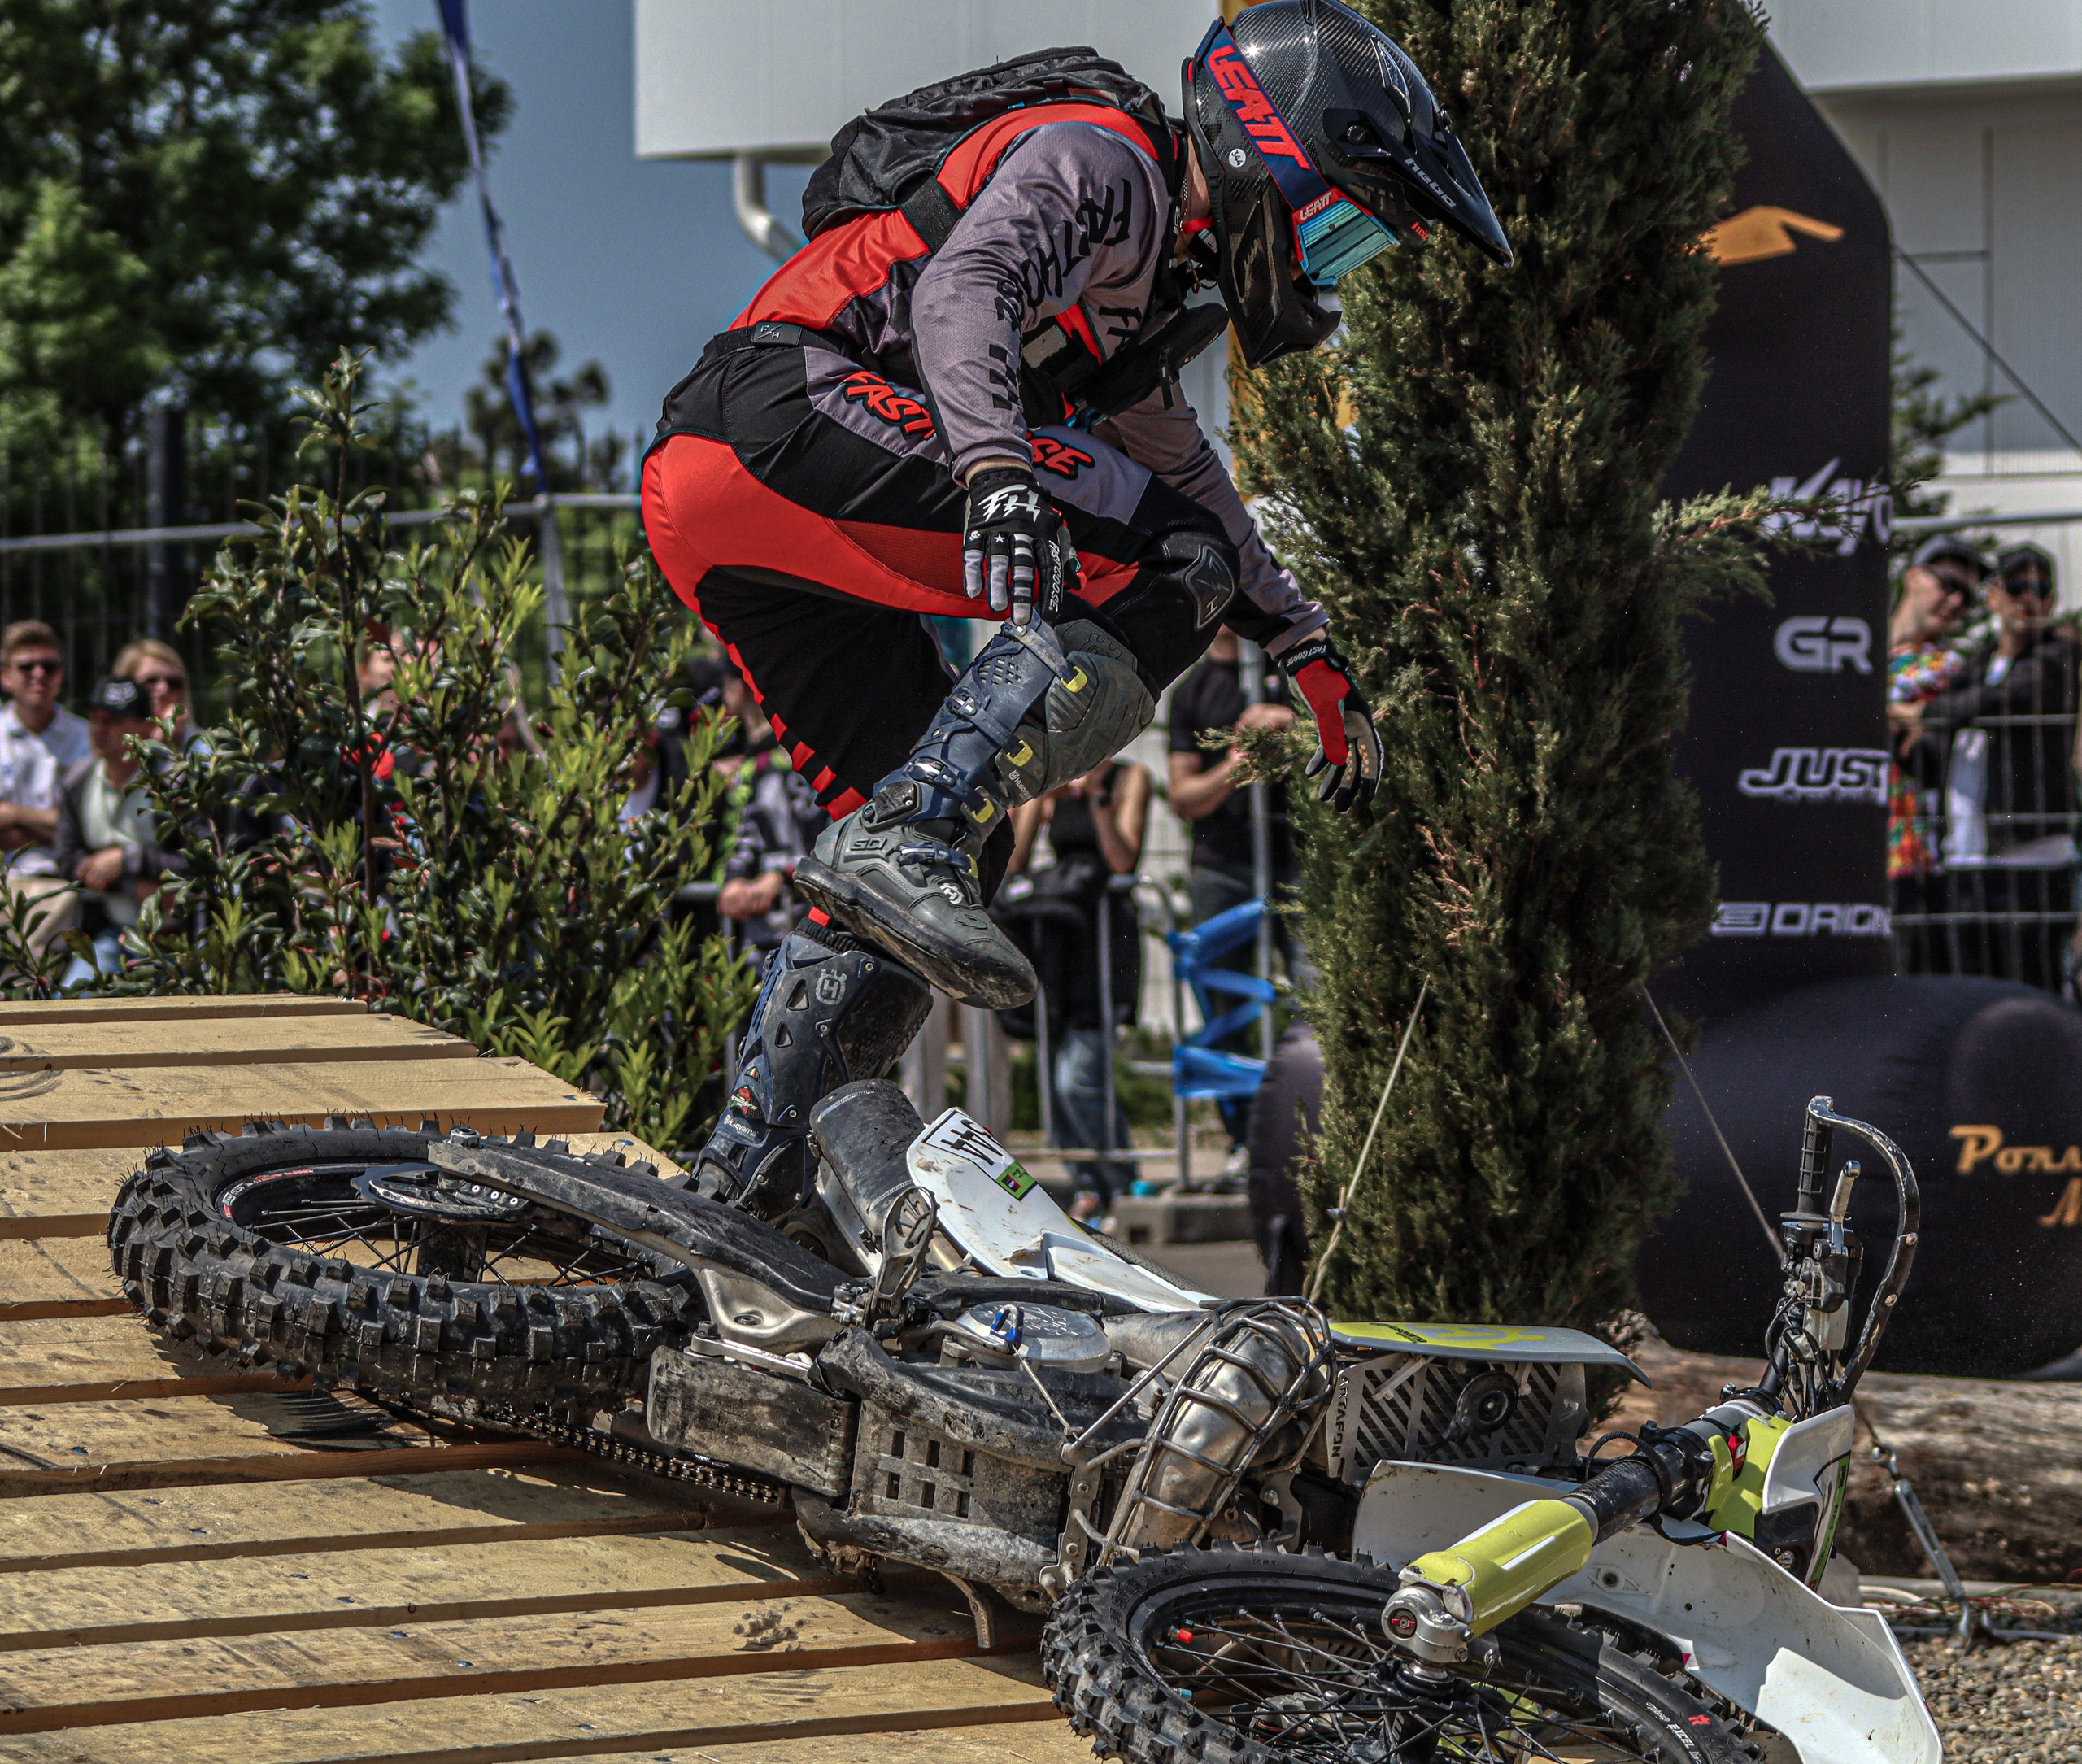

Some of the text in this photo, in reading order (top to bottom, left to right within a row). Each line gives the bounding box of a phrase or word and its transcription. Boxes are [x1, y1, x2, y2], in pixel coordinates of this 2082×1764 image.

[1207, 45, 1310, 171] LEATT
[1299, 190, 1334, 221] LEATT
[1404, 158, 1457, 208] hebo
[1775, 616, 1871, 674] GR
[1667, 1723, 1696, 1749] EXCEL
